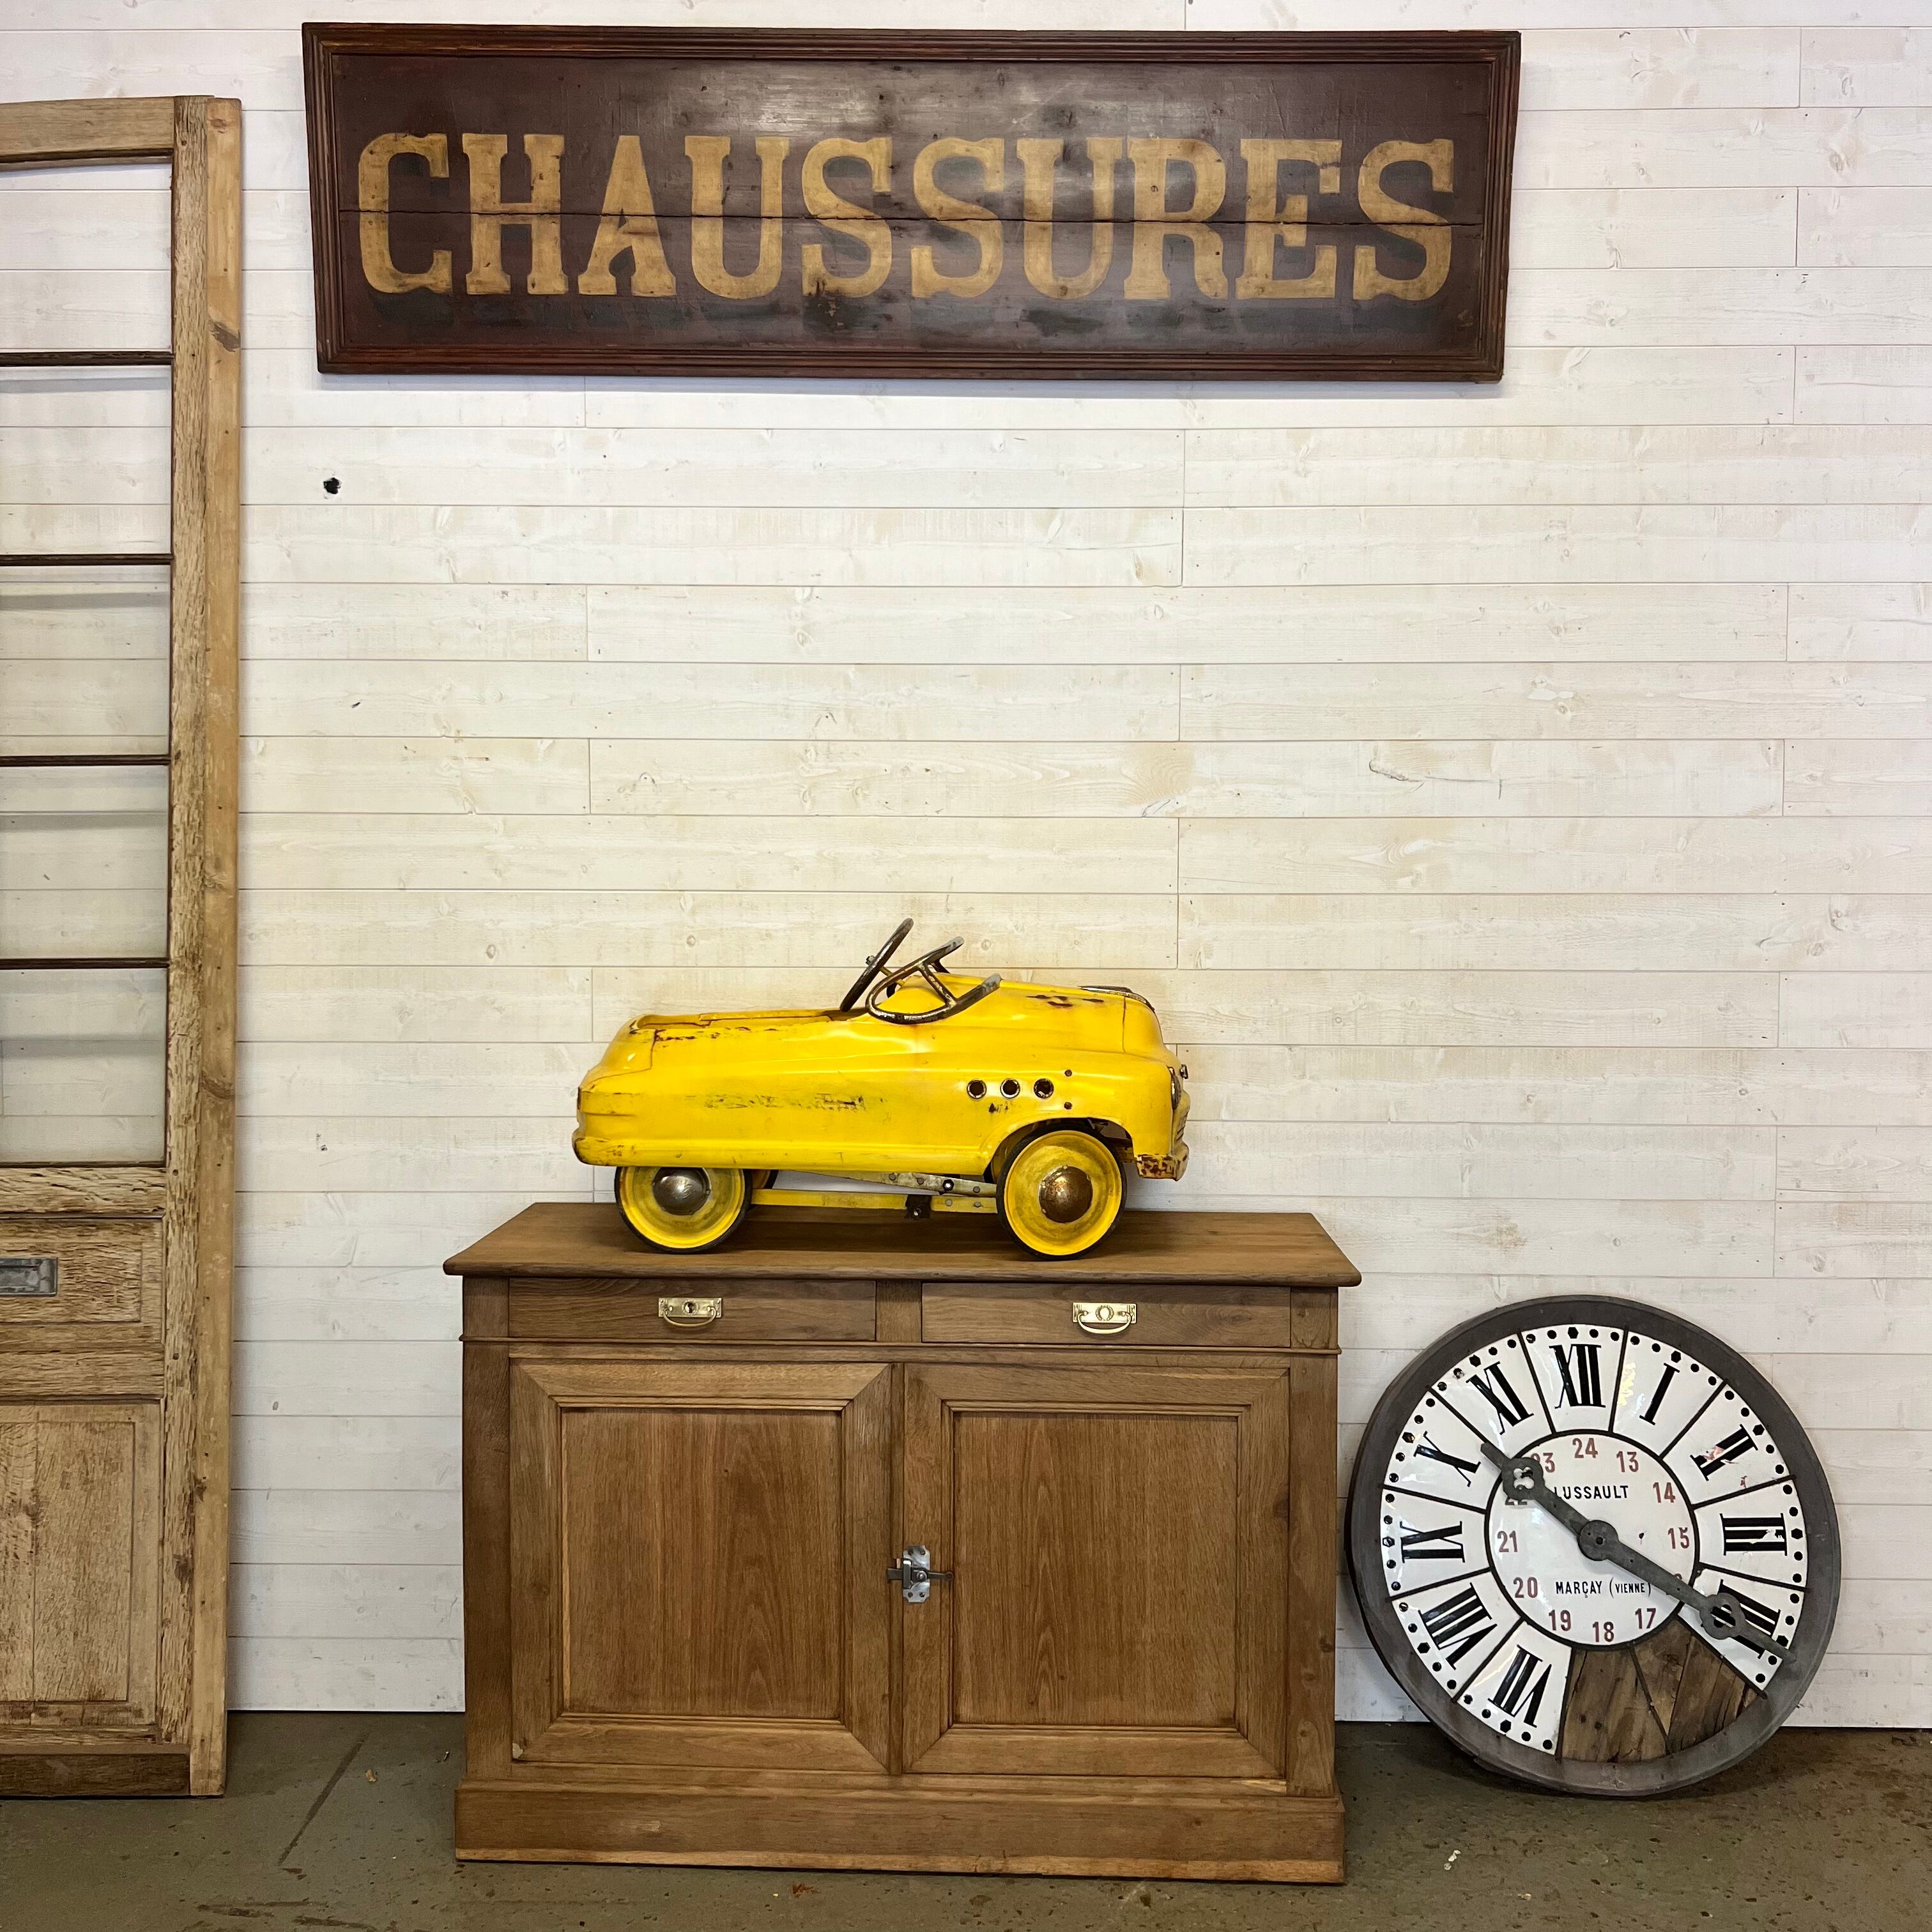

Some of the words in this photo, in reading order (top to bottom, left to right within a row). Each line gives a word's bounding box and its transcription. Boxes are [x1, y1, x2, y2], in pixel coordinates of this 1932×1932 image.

[358, 132, 1453, 301] CHAUSSURES
[1549, 1344, 1606, 1409] XII
[1466, 1361, 1534, 1435] XI
[1639, 1363, 1680, 1425] I
[1413, 1431, 1481, 1487] X
[1572, 1438, 1598, 1459] 24
[1690, 1424, 1758, 1481] II
[1616, 1451, 1639, 1472] 13
[1554, 1485, 1629, 1499] LUSSAULT
[1653, 1482, 1676, 1503] 14
[1399, 1521, 1465, 1563] IX
[1497, 1530, 1518, 1552] 21
[1667, 1527, 1690, 1549] 15
[1720, 1513, 1787, 1556] III
[1513, 1576, 1538, 1598] 20
[1556, 1581, 1602, 1596] MARÇAY
[1609, 1576, 1652, 1598] (VIENNE)
[1418, 1583, 1498, 1670] VIII
[1548, 1609, 1572, 1632] 19
[1635, 1607, 1657, 1630] 17
[1592, 1621, 1615, 1643] 18
[1487, 1644, 1552, 1728] VII
